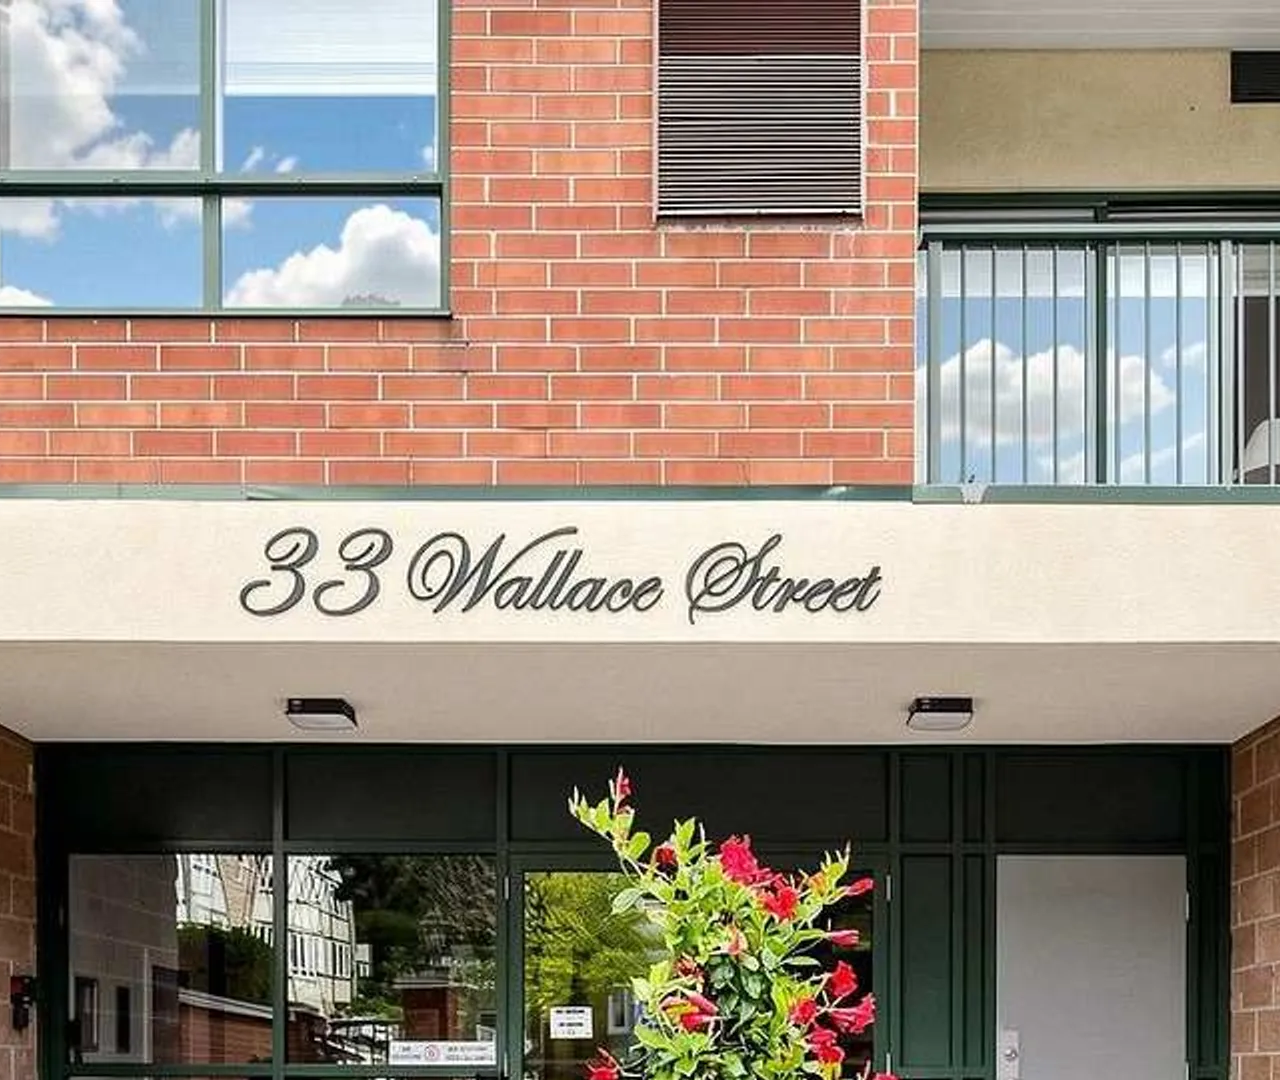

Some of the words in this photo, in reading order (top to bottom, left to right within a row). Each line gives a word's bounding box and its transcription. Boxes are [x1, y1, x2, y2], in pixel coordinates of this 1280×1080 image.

[240, 526, 393, 617] 33
[407, 526, 664, 614] Wallace
[685, 533, 881, 625] Street
